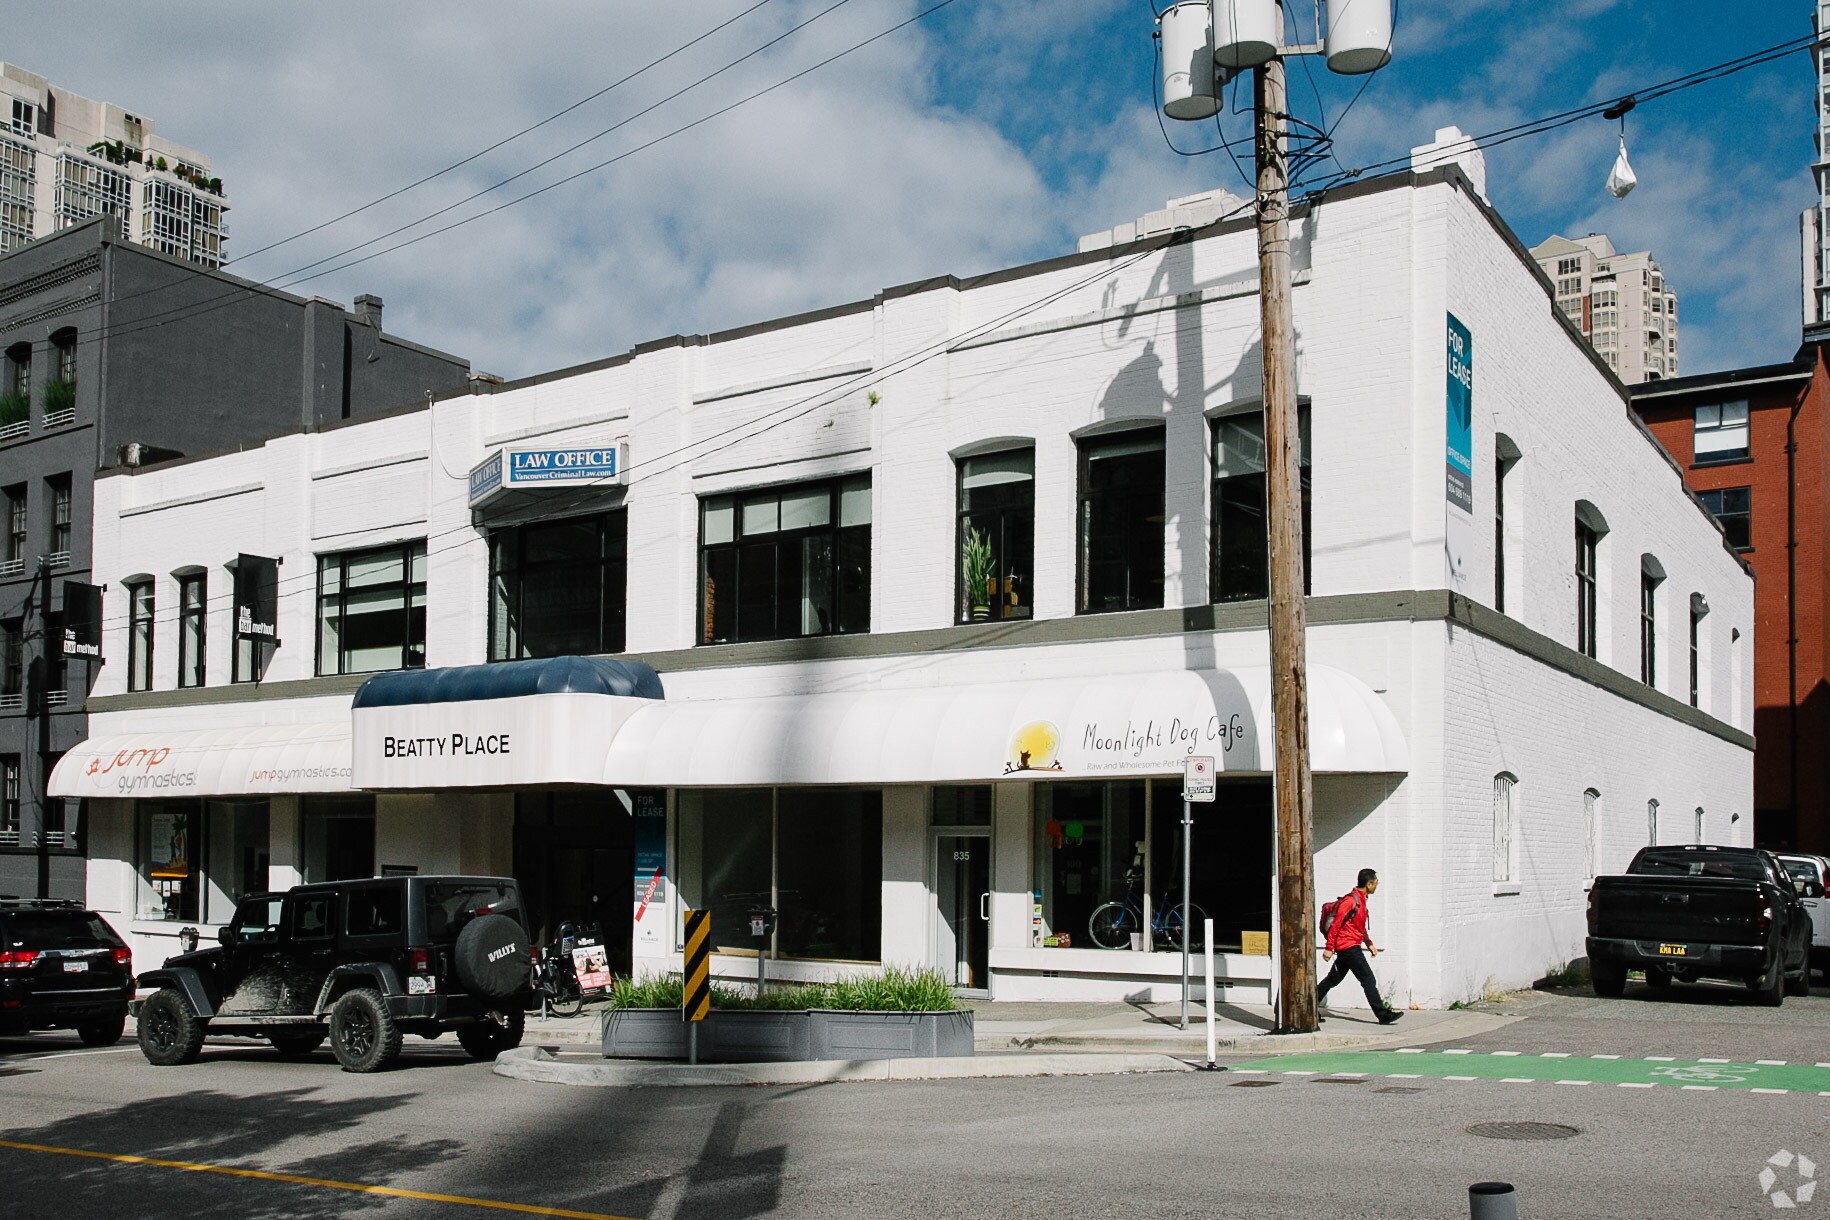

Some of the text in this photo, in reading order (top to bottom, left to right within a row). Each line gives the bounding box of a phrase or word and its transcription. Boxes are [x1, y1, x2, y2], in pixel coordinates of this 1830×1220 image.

[1448, 327, 1463, 357] FOR
[1448, 353, 1471, 390] LEASE
[515, 450, 612, 469] LAW OFFICE
[240, 605, 251, 618] the
[65, 628, 76, 640] the
[240, 620, 274, 636] bar method
[64, 641, 98, 656] bar method
[1083, 713, 1243, 757] Moonlight Dog Cafe
[384, 733, 510, 757] BEATTY PLACE
[102, 747, 170, 774] jump
[1103, 761, 1117, 770] and
[1118, 760, 1162, 769] Wholesome
[1163, 759, 1175, 768] Pet
[118, 768, 195, 794] gymnastics
[637, 795, 655, 806] FOR
[637, 807, 664, 817] LEASE
[953, 851, 970, 861] 835
[641, 880, 657, 908] LEASED
